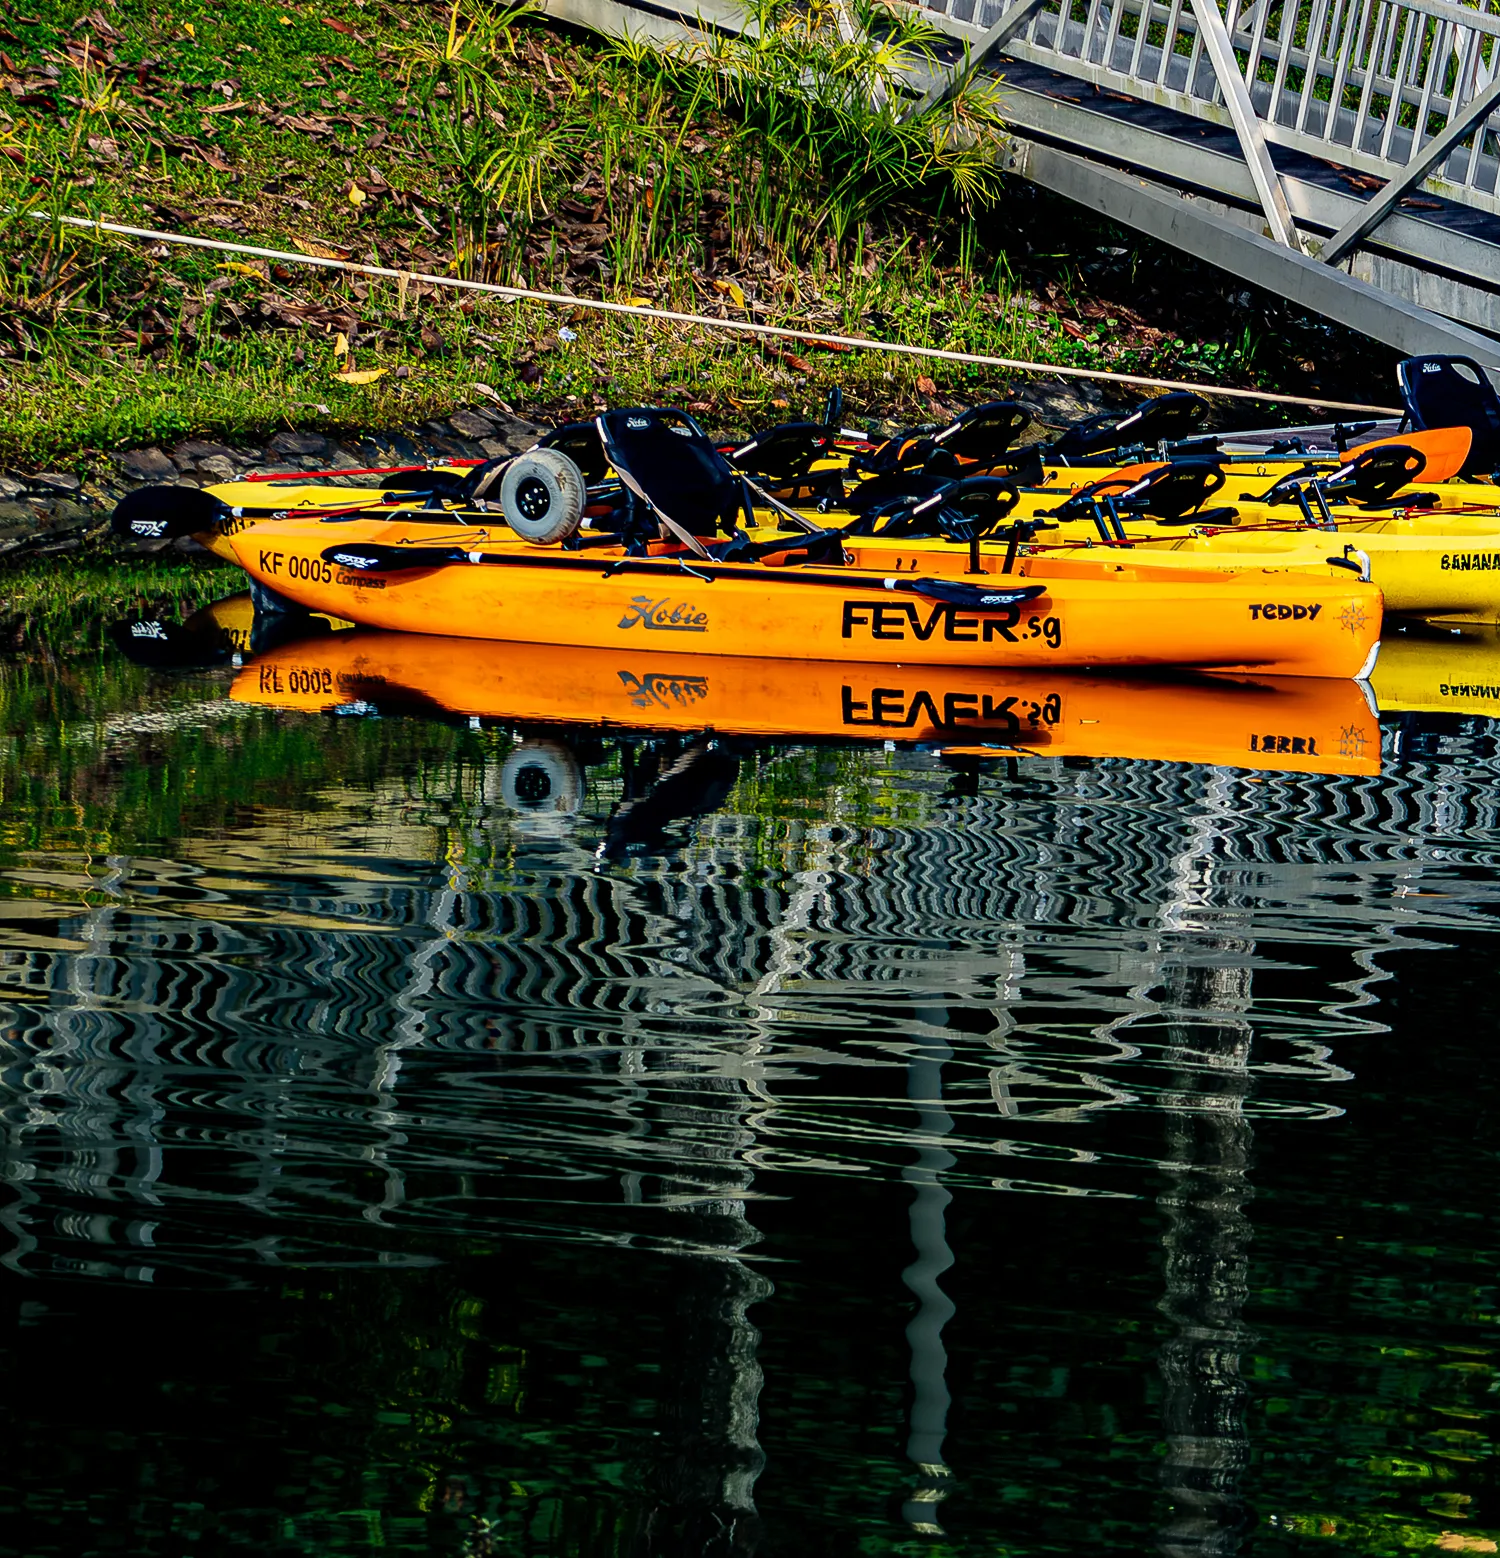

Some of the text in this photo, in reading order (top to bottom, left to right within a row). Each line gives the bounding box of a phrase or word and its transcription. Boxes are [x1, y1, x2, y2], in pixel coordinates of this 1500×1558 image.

[259, 549, 332, 584] KF 0005
[335, 571, 387, 590] Compass
[617, 595, 709, 632] Hobie
